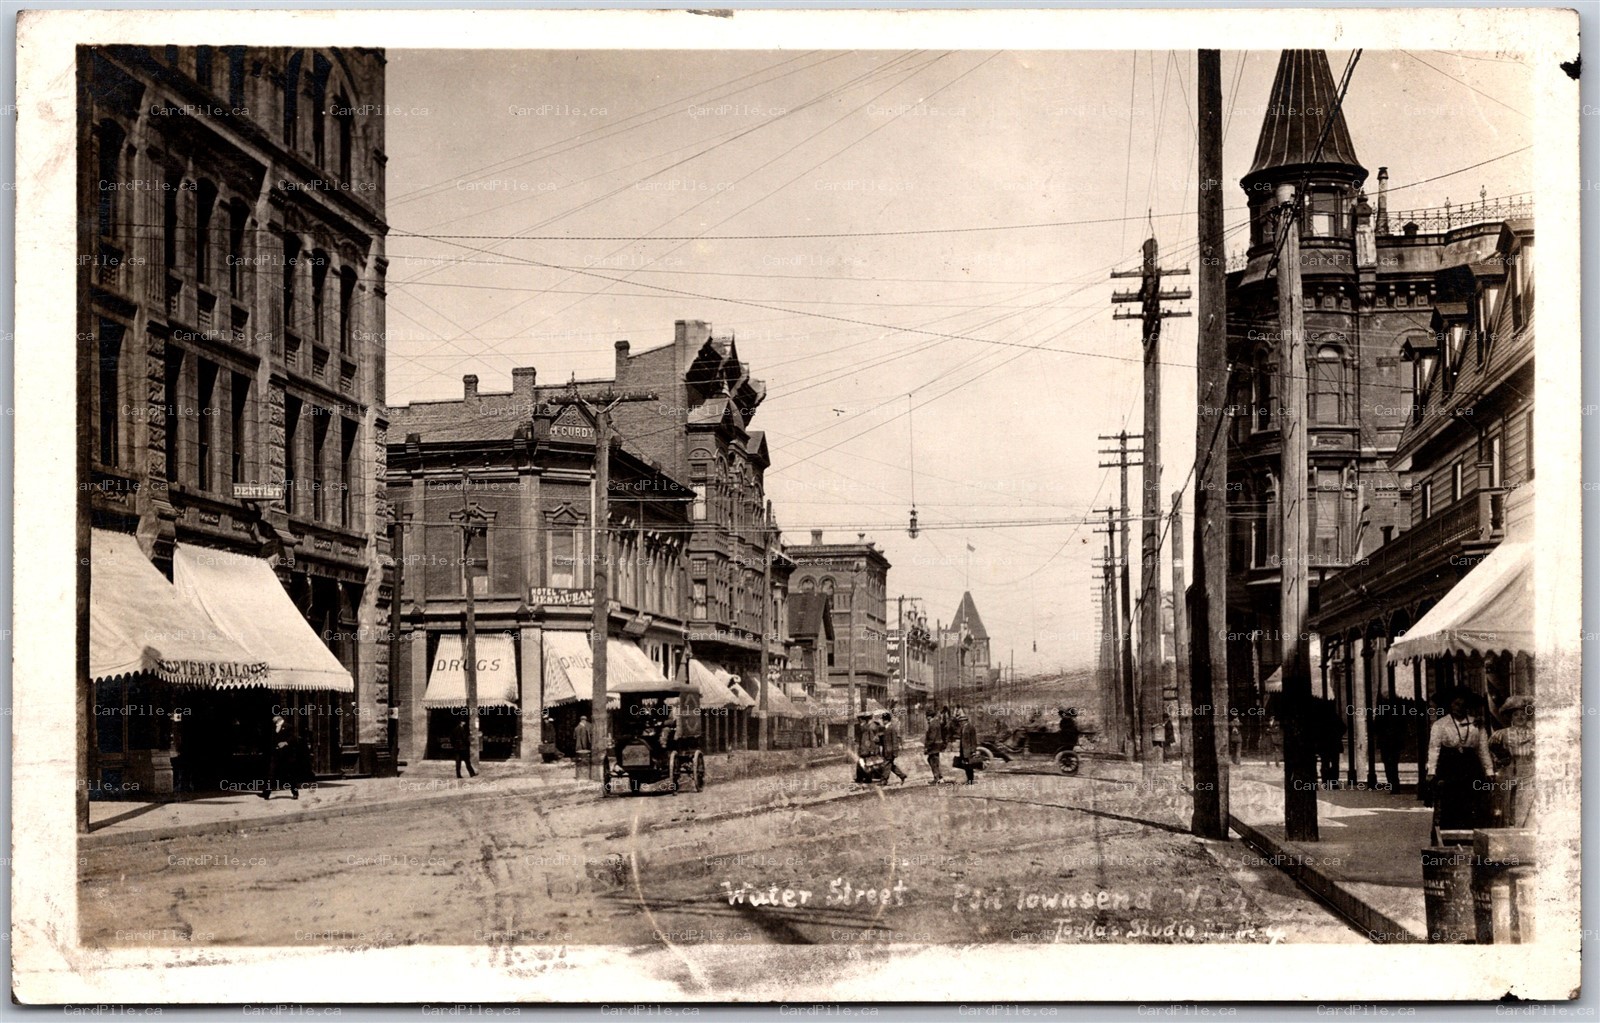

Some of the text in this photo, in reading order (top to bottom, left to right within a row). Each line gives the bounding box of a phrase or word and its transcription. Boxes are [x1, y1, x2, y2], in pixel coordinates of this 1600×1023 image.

[233, 486, 281, 497] DENTIST
[531, 587, 557, 596] HOTEL
[559, 655, 594, 670] DRUG
